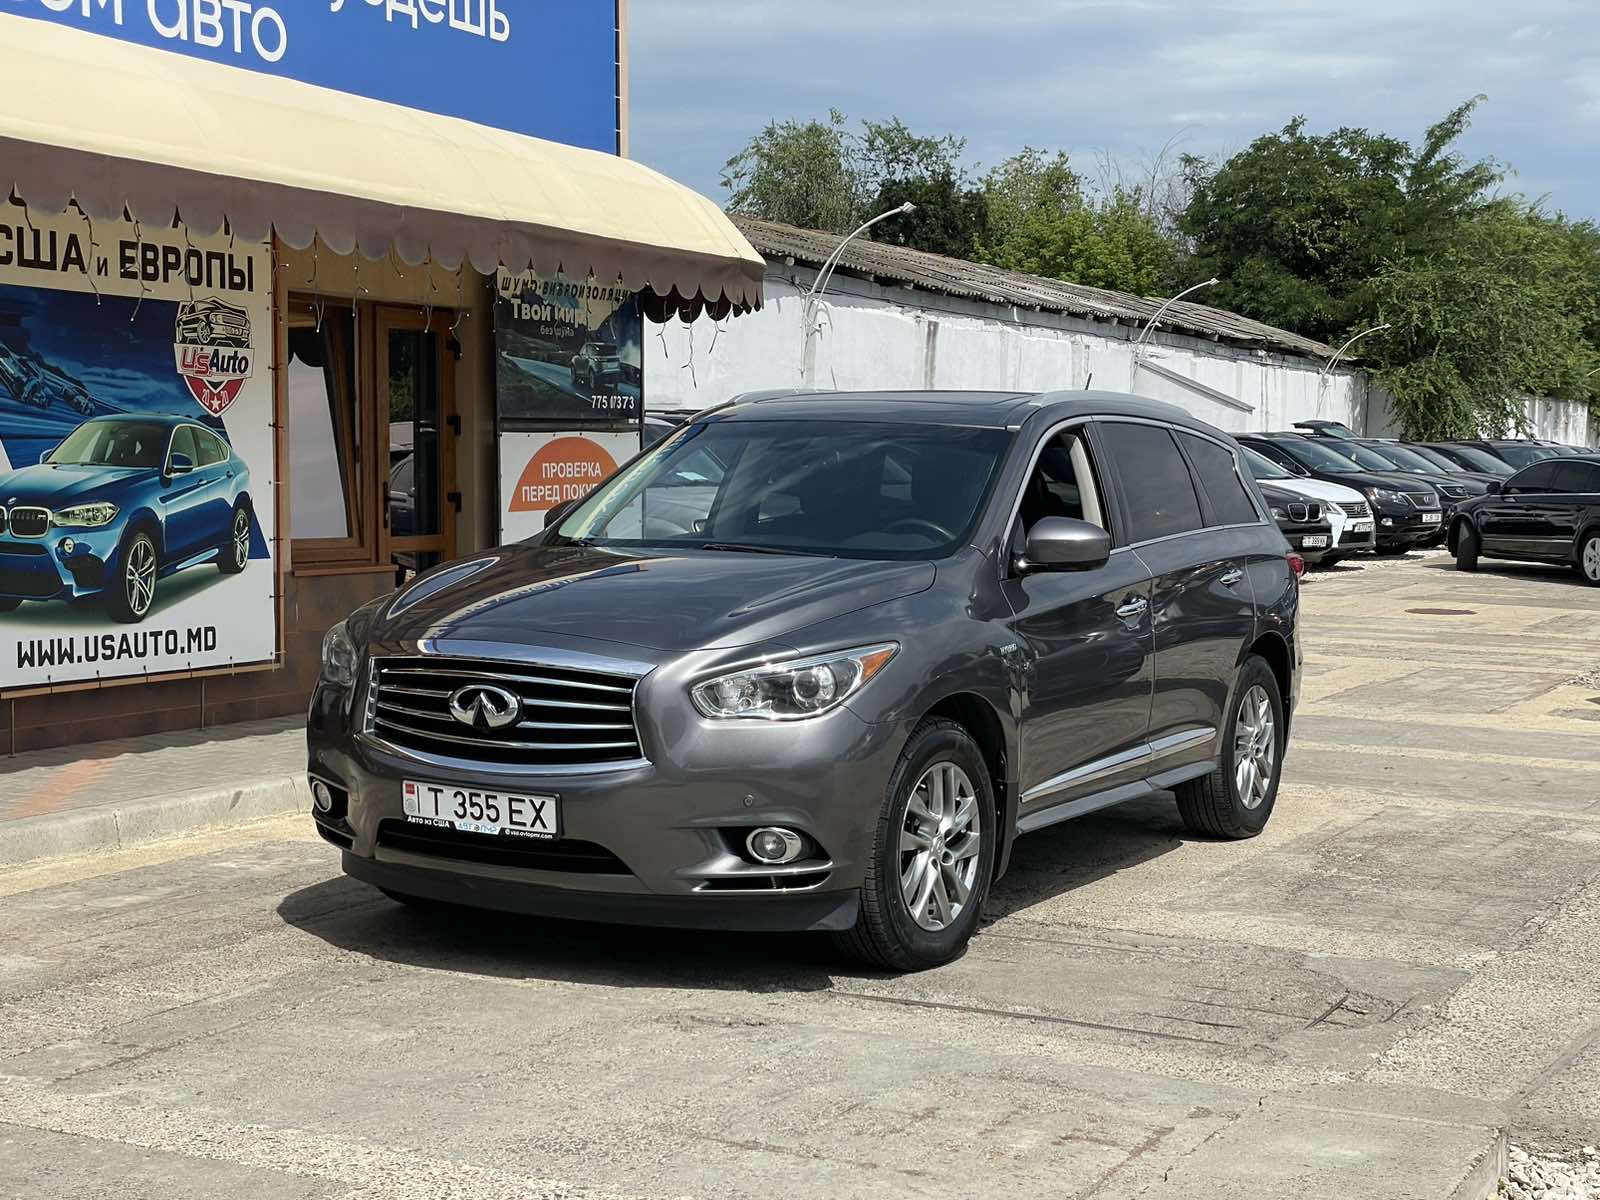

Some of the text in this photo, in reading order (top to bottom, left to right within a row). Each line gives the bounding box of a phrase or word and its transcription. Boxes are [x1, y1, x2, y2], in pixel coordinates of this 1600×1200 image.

[147, 0, 288, 62] авто
[96, 256, 108, 277] и
[119, 239, 254, 292] ЕВРОПЫ
[591, 395, 608, 409] 775
[542, 462, 602, 479] ПРОВЕРКА
[522, 484, 560, 503] ПЕРЕД
[17, 626, 216, 668] WWW.USAUTO.MD
[427, 786, 548, 829] T 355 EX
